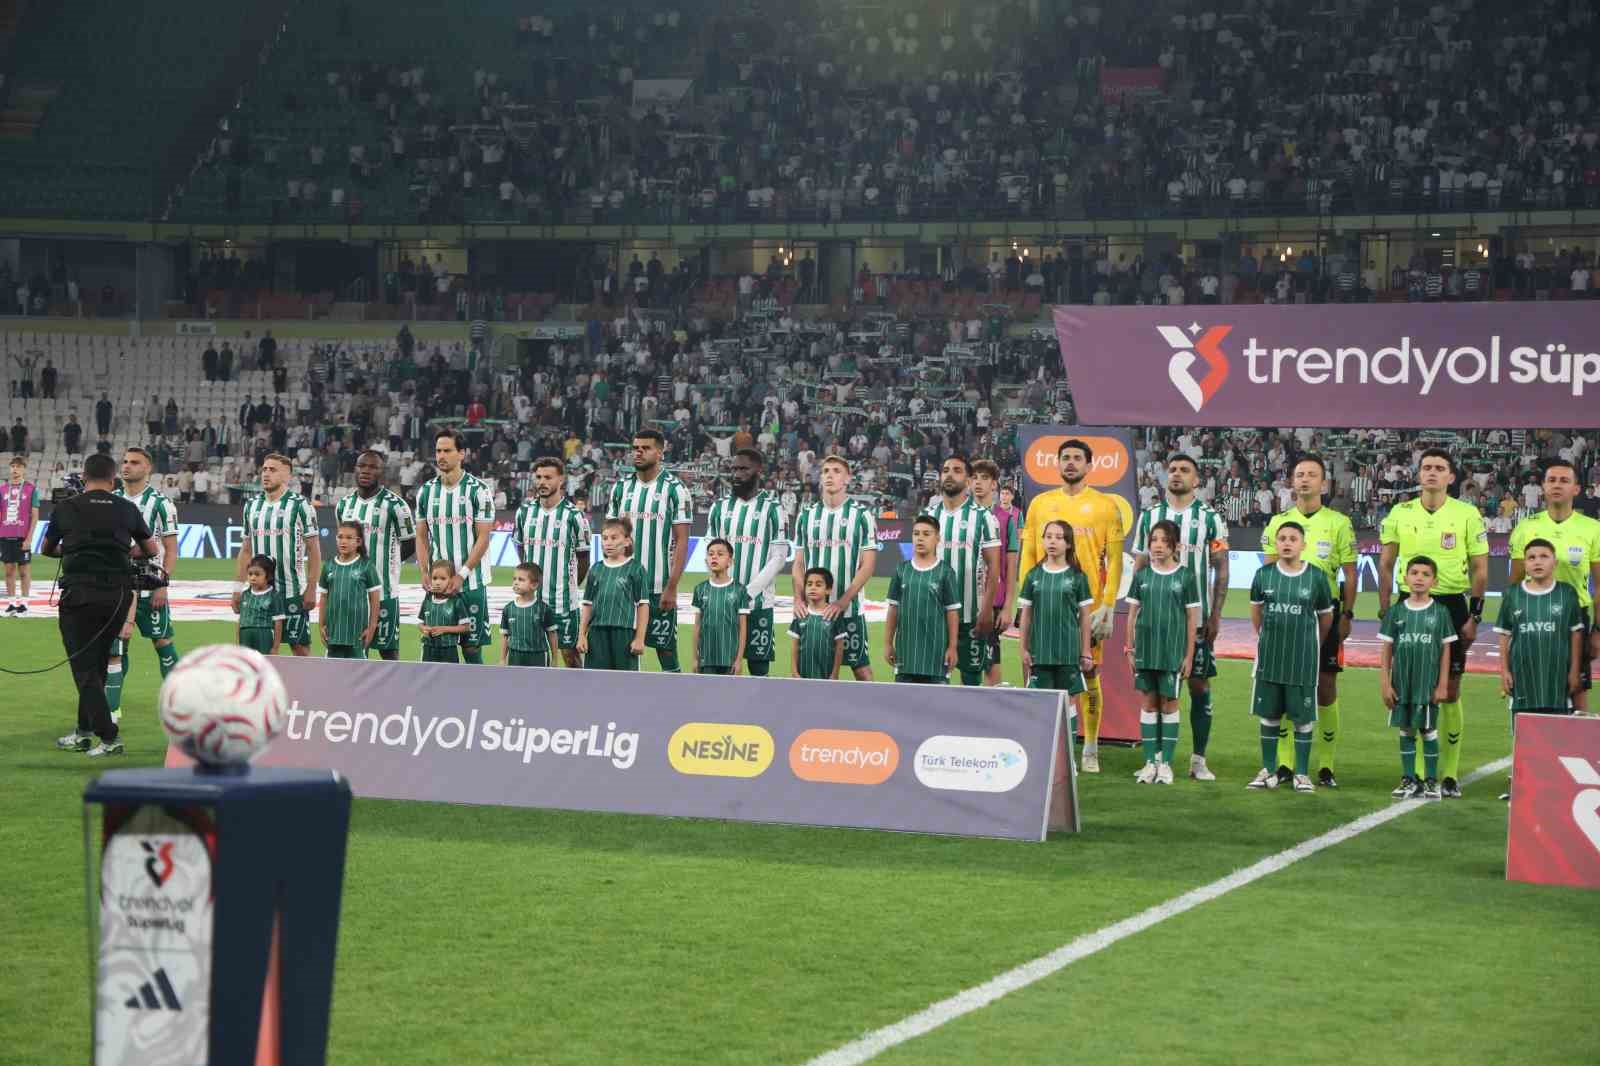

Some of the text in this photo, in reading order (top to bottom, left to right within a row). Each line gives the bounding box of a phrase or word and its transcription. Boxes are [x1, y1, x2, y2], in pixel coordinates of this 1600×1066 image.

[1242, 335, 1501, 395] trendyol
[1035, 449, 1120, 472] tryol
[151, 610, 160, 625] 9
[1269, 603, 1302, 615] SAYGI
[286, 614, 301, 631] 77
[379, 621, 390, 637] 11
[562, 618, 571, 635] 7
[651, 619, 670, 636] 22
[1519, 622, 1556, 633] SAYGI
[750, 629, 769, 646] 26
[1399, 632, 1432, 644] SAYGI
[970, 640, 980, 656] 5
[286, 700, 479, 756] trendyol
[799, 743, 889, 769] trendyol
[922, 753, 999, 769] Türk Telekom
